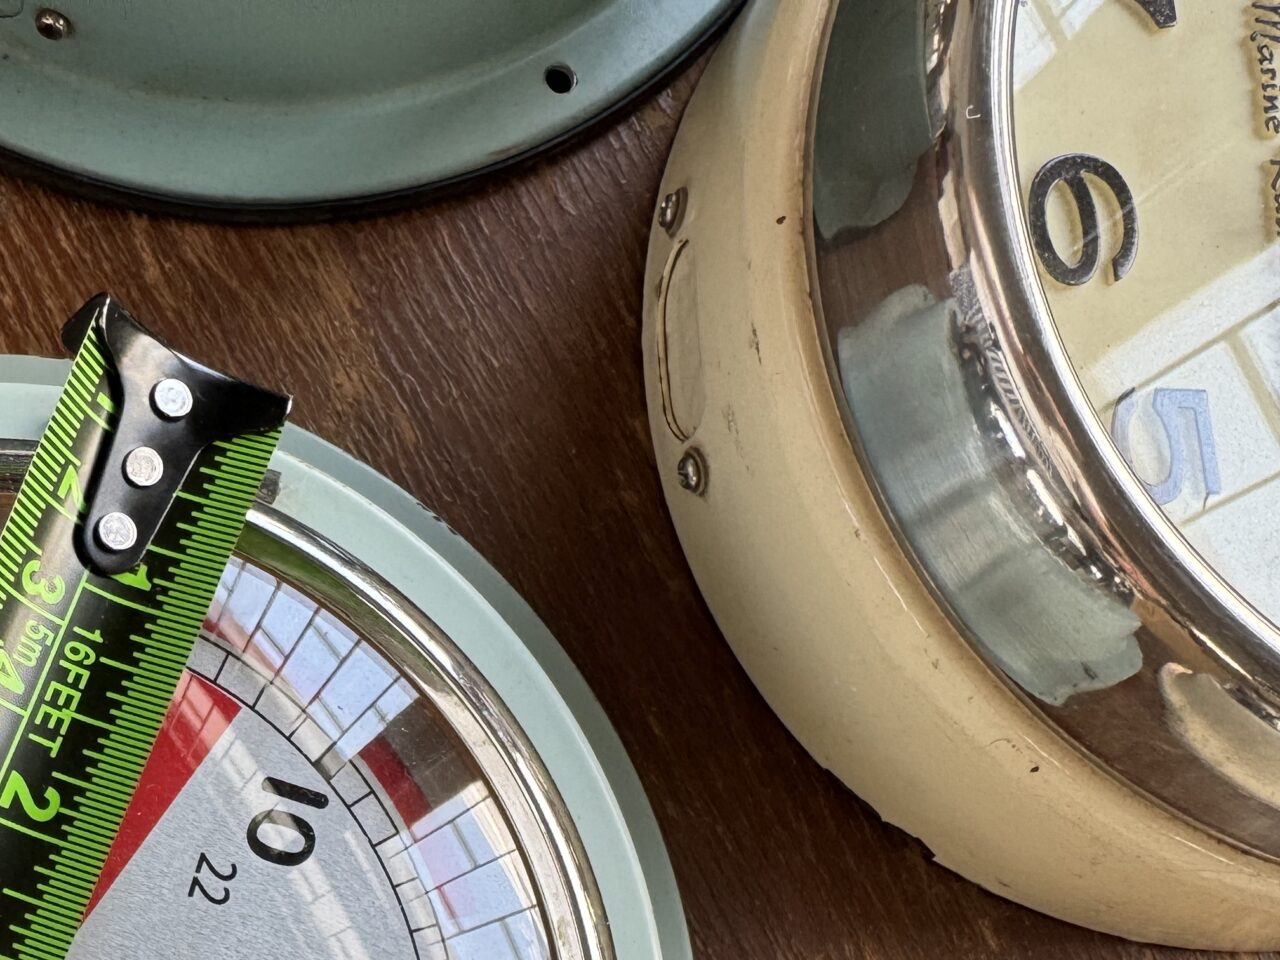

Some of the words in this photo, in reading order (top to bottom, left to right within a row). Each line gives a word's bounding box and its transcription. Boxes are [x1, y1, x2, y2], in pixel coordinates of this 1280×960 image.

[1028, 152, 1139, 286] 6
[1111, 387, 1220, 506] 5
[22, 560, 65, 604] 3
[12, 620, 55, 667] 5m
[28, 625, 104, 758] 16FEET
[247, 776, 329, 866] 10
[187, 852, 238, 905] 22
